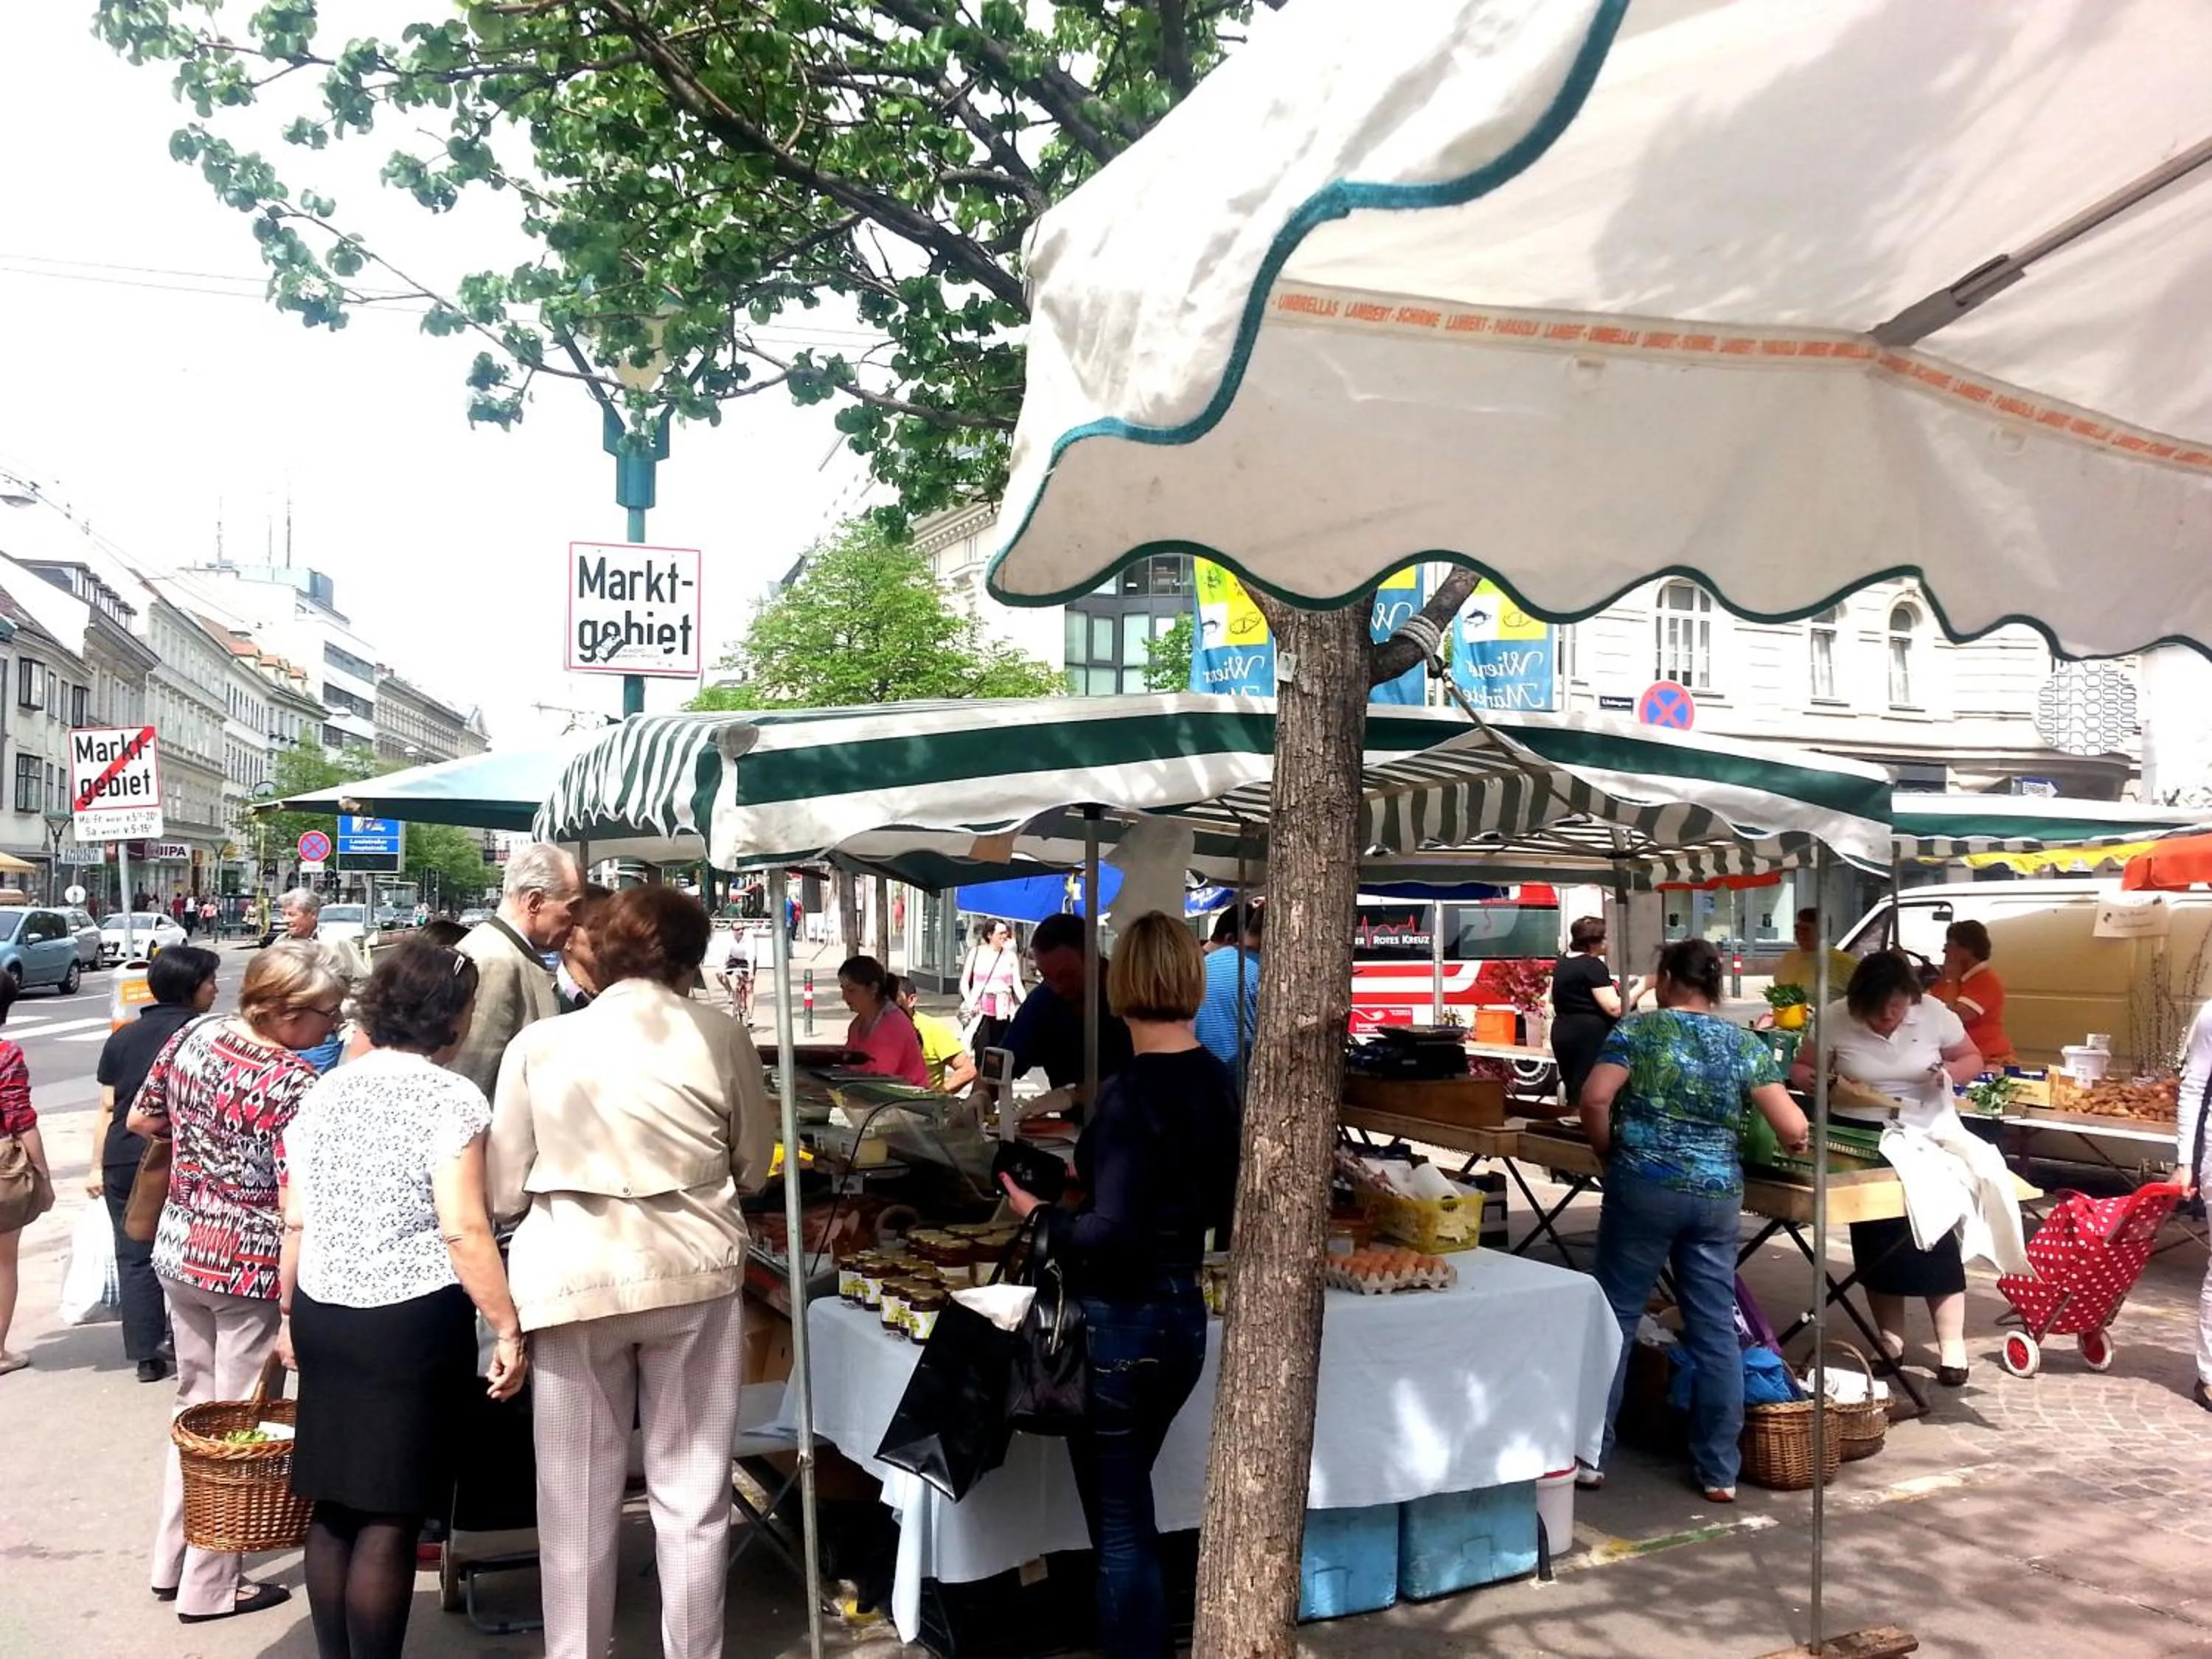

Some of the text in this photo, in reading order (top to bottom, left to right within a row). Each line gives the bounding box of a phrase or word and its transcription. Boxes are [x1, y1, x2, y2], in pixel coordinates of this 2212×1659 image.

[1278, 293, 1339, 317] UMBRELLAS
[1344, 301, 1393, 322] LAMBERT
[579, 555, 693, 603] Markt-
[75, 733, 150, 763] Markt-
[80, 768, 150, 805] gebiet
